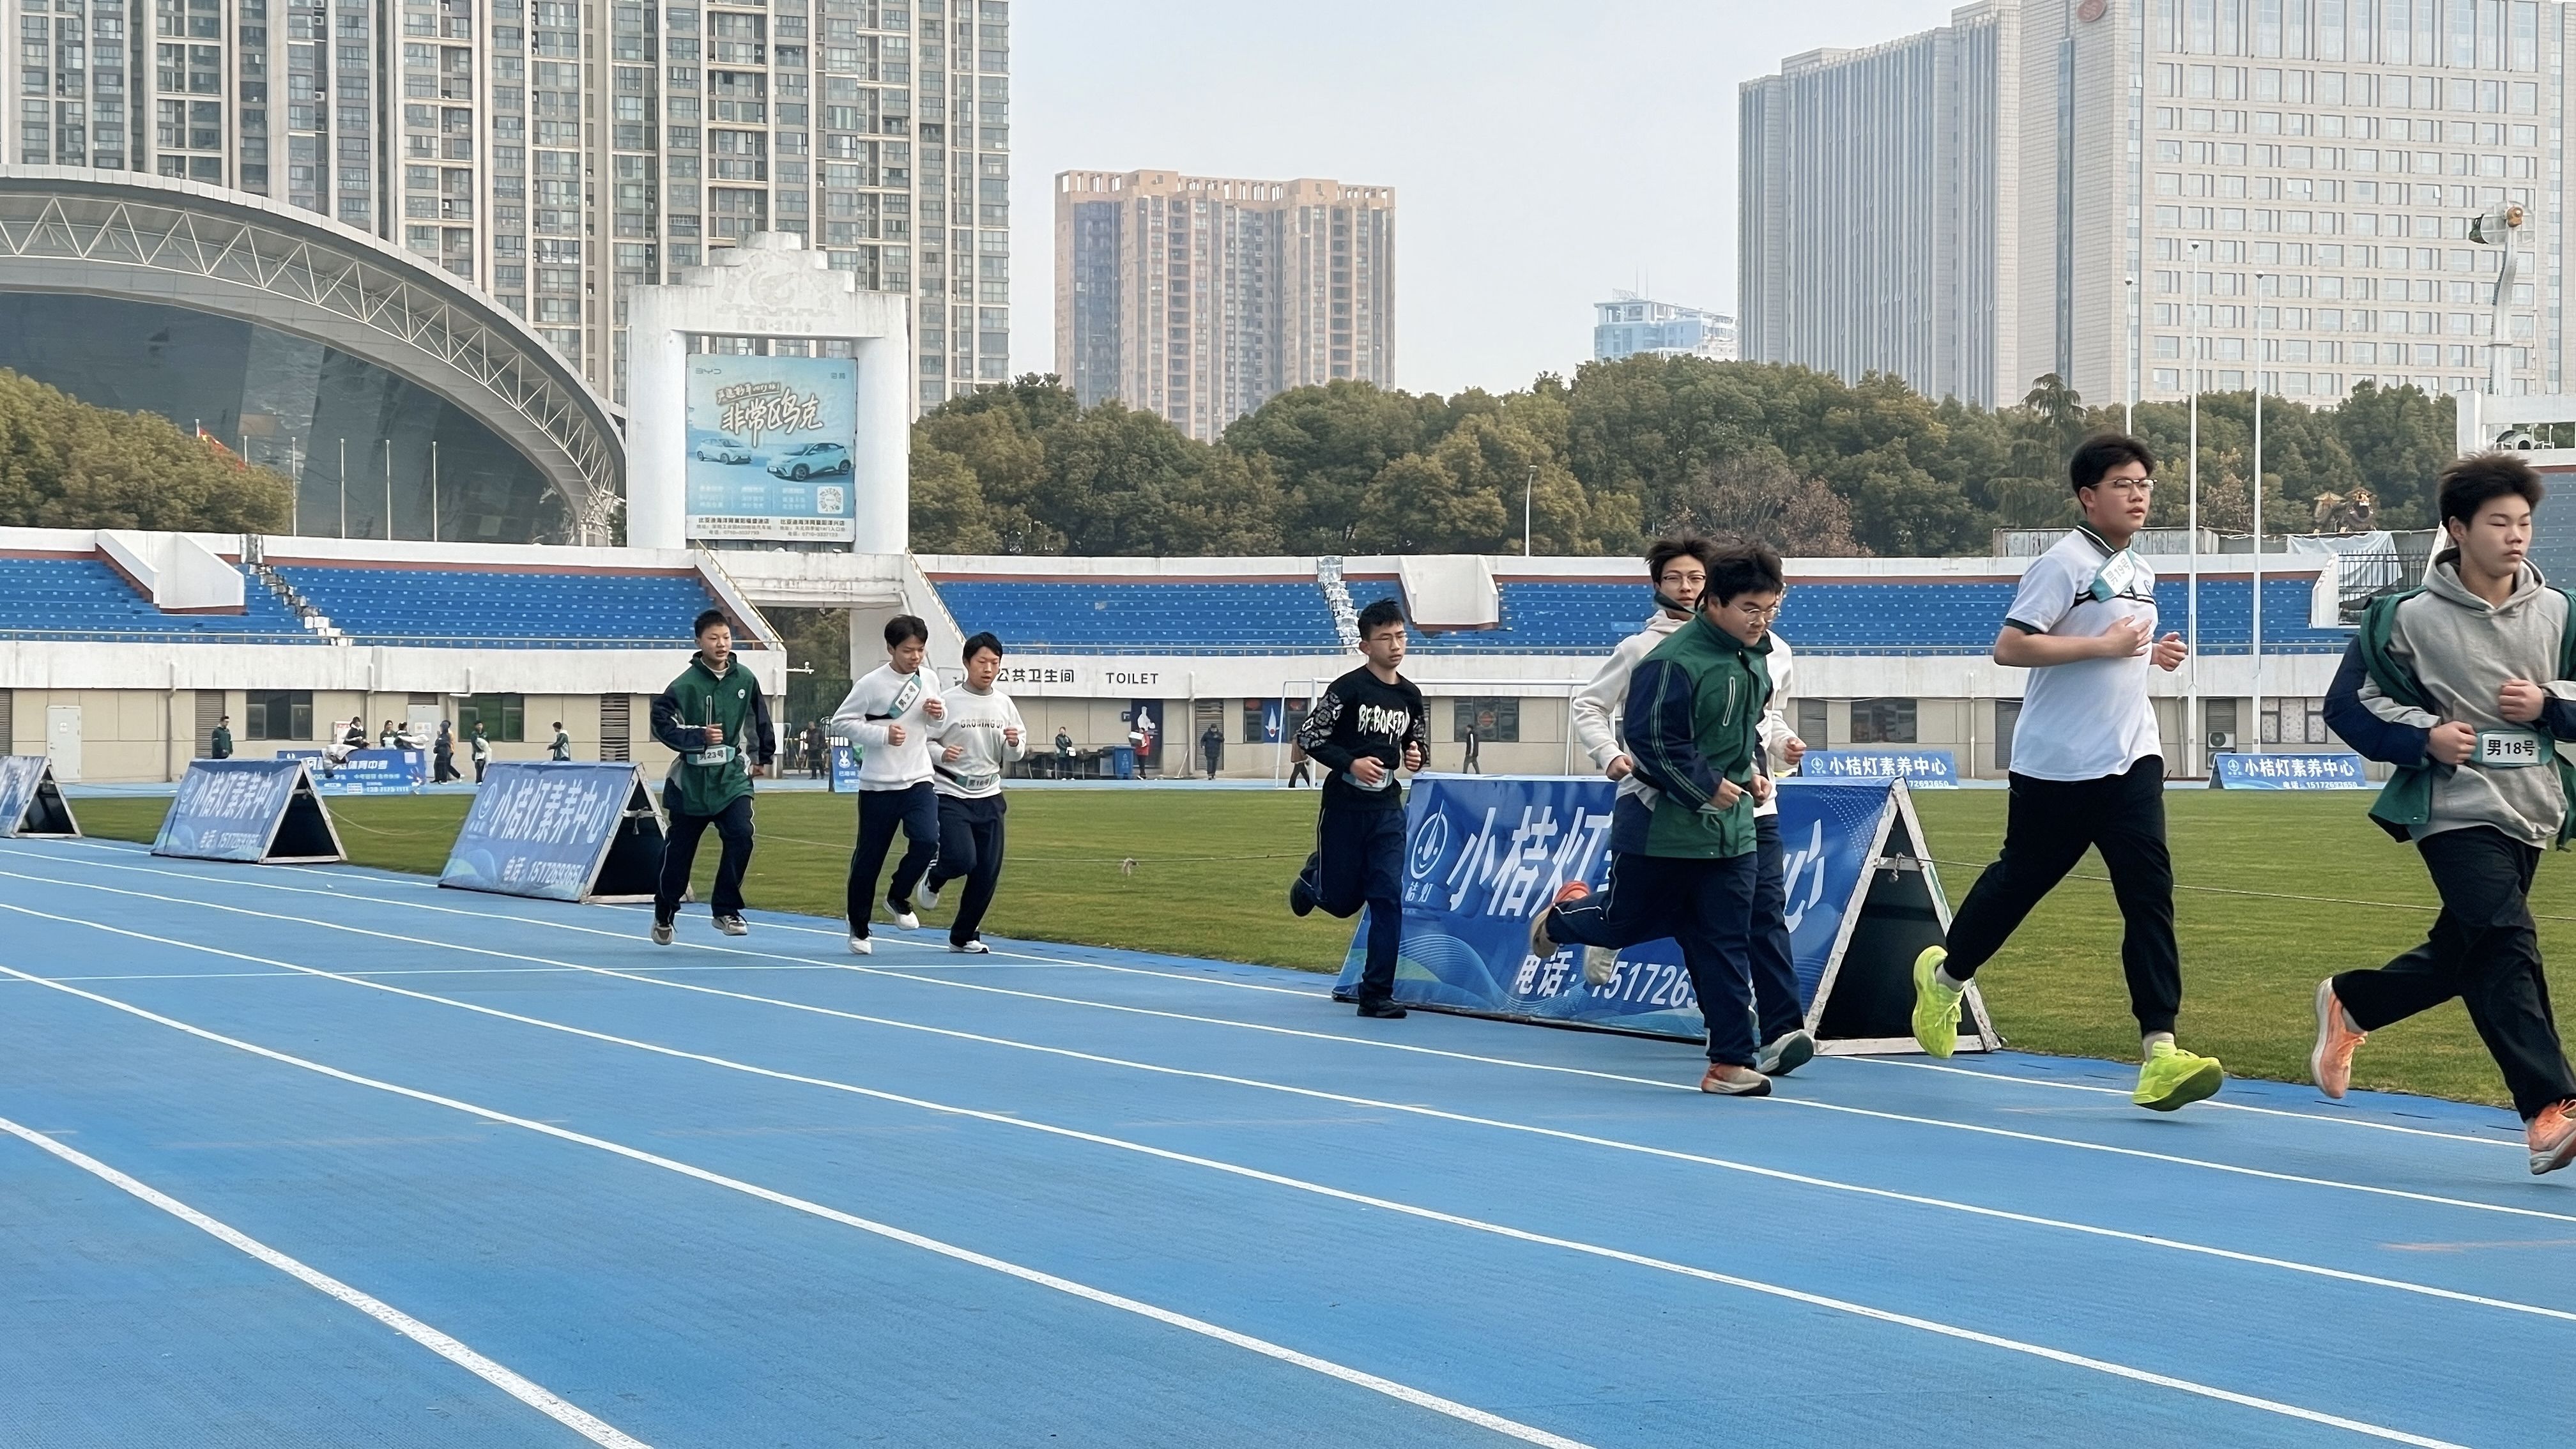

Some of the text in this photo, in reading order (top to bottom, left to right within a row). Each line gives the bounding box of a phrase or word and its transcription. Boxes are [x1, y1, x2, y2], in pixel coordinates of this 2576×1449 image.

[2106, 558, 2130, 585] 男19号
[997, 668, 1159, 684] 公共卫生间 TOILET
[2487, 739, 2535, 756] 男18号
[1830, 756, 1947, 776] 小桔灯素养中心
[2244, 758, 2355, 778] 小桔灯素养中心
[190, 772, 283, 820] 小桔灯素养中心
[489, 778, 612, 844] 小桔灯素养中心
[1405, 881, 1434, 903] 桔灯
